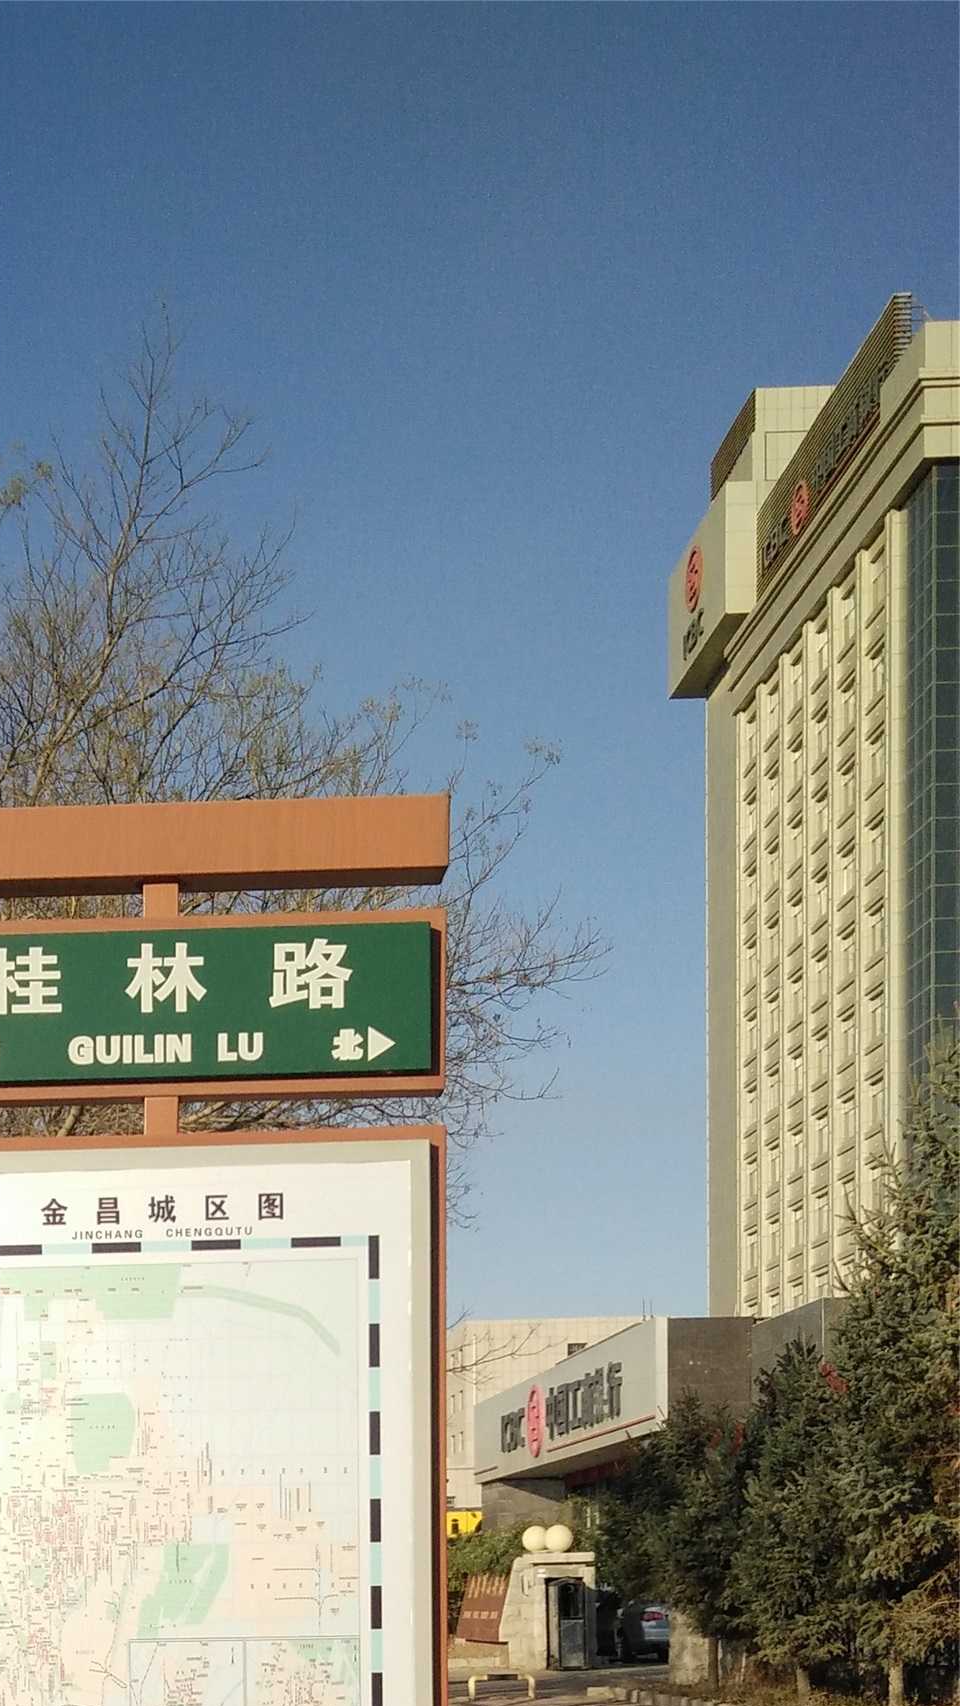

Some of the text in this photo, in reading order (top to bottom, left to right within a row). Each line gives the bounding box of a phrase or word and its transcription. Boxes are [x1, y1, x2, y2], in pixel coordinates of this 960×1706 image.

[68, 1032, 264, 1066] GUILIN LU
[332, 1029, 364, 1061] 北
[40, 1192, 284, 1226] 金昌城区图
[72, 1226, 254, 1241] JINCHANG CHENGQUTU
